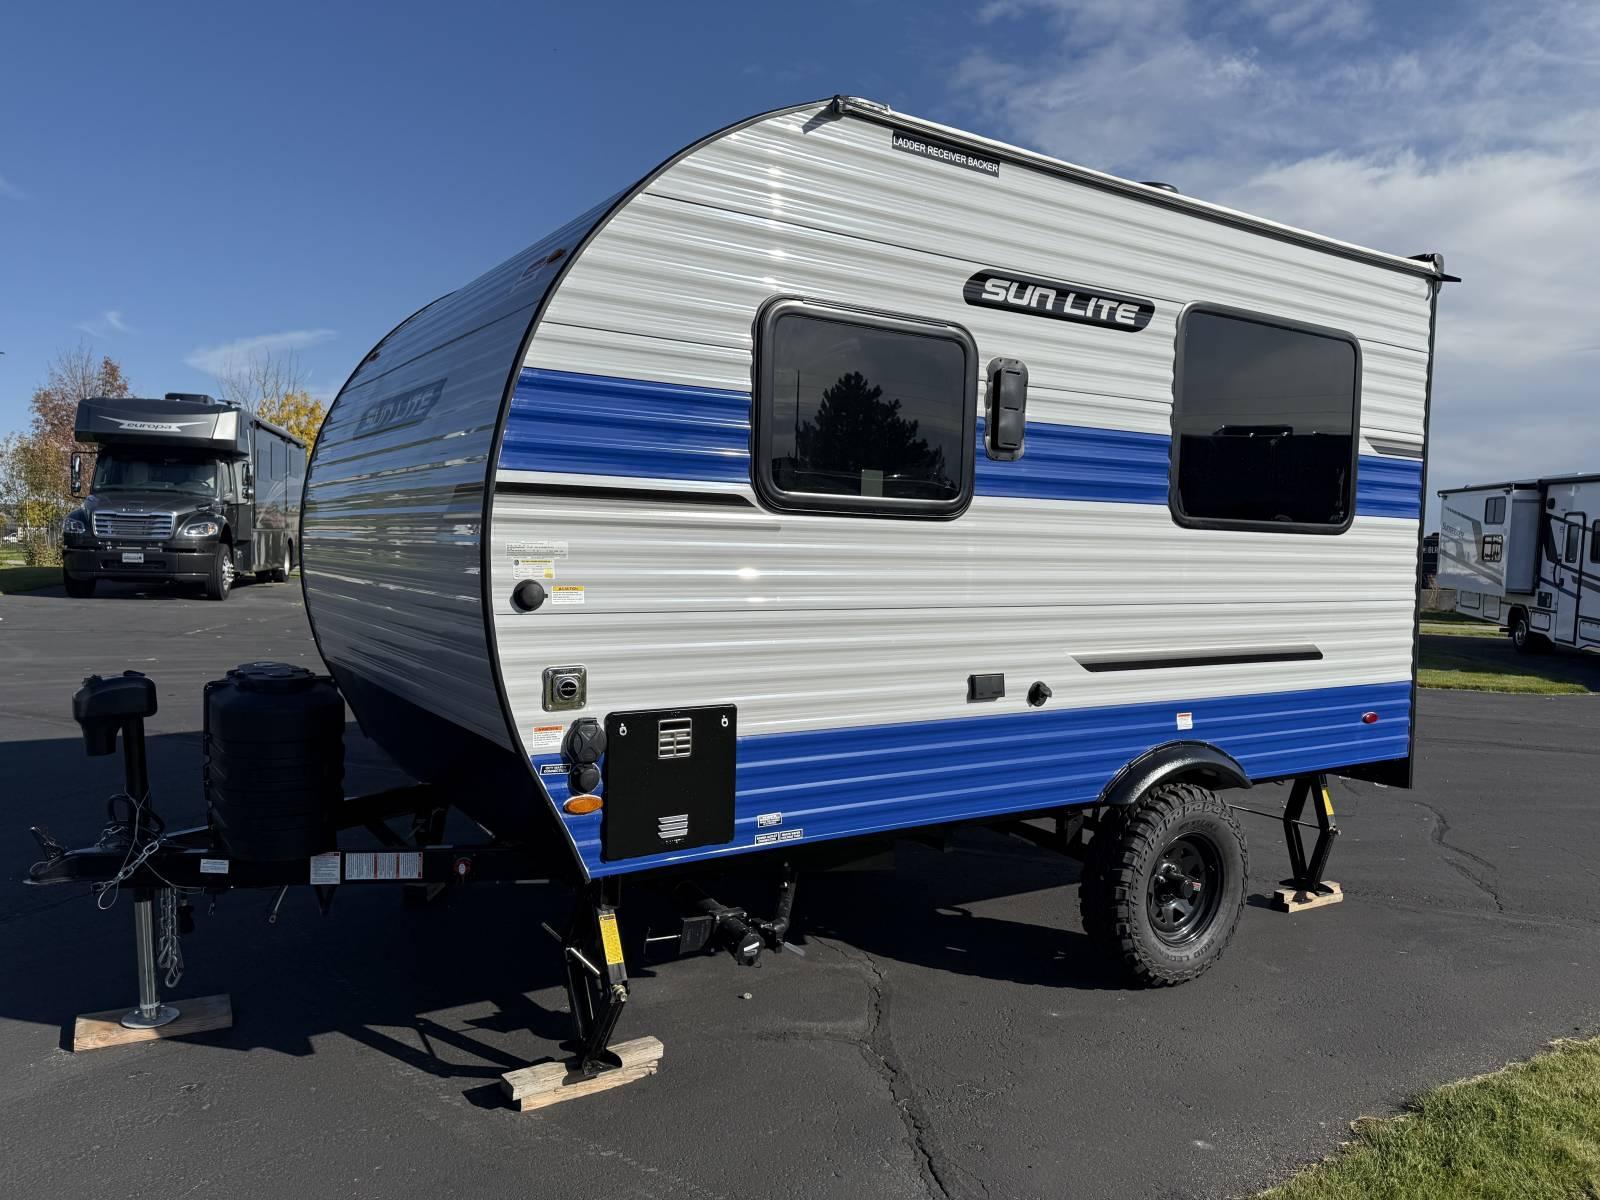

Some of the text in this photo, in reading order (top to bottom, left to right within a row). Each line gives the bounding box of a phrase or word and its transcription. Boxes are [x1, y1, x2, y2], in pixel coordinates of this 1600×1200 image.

[893, 136, 999, 173] LADDER RECEIVER BACKER
[981, 278, 1141, 325] SUN LITE
[126, 423, 173, 431] europa
